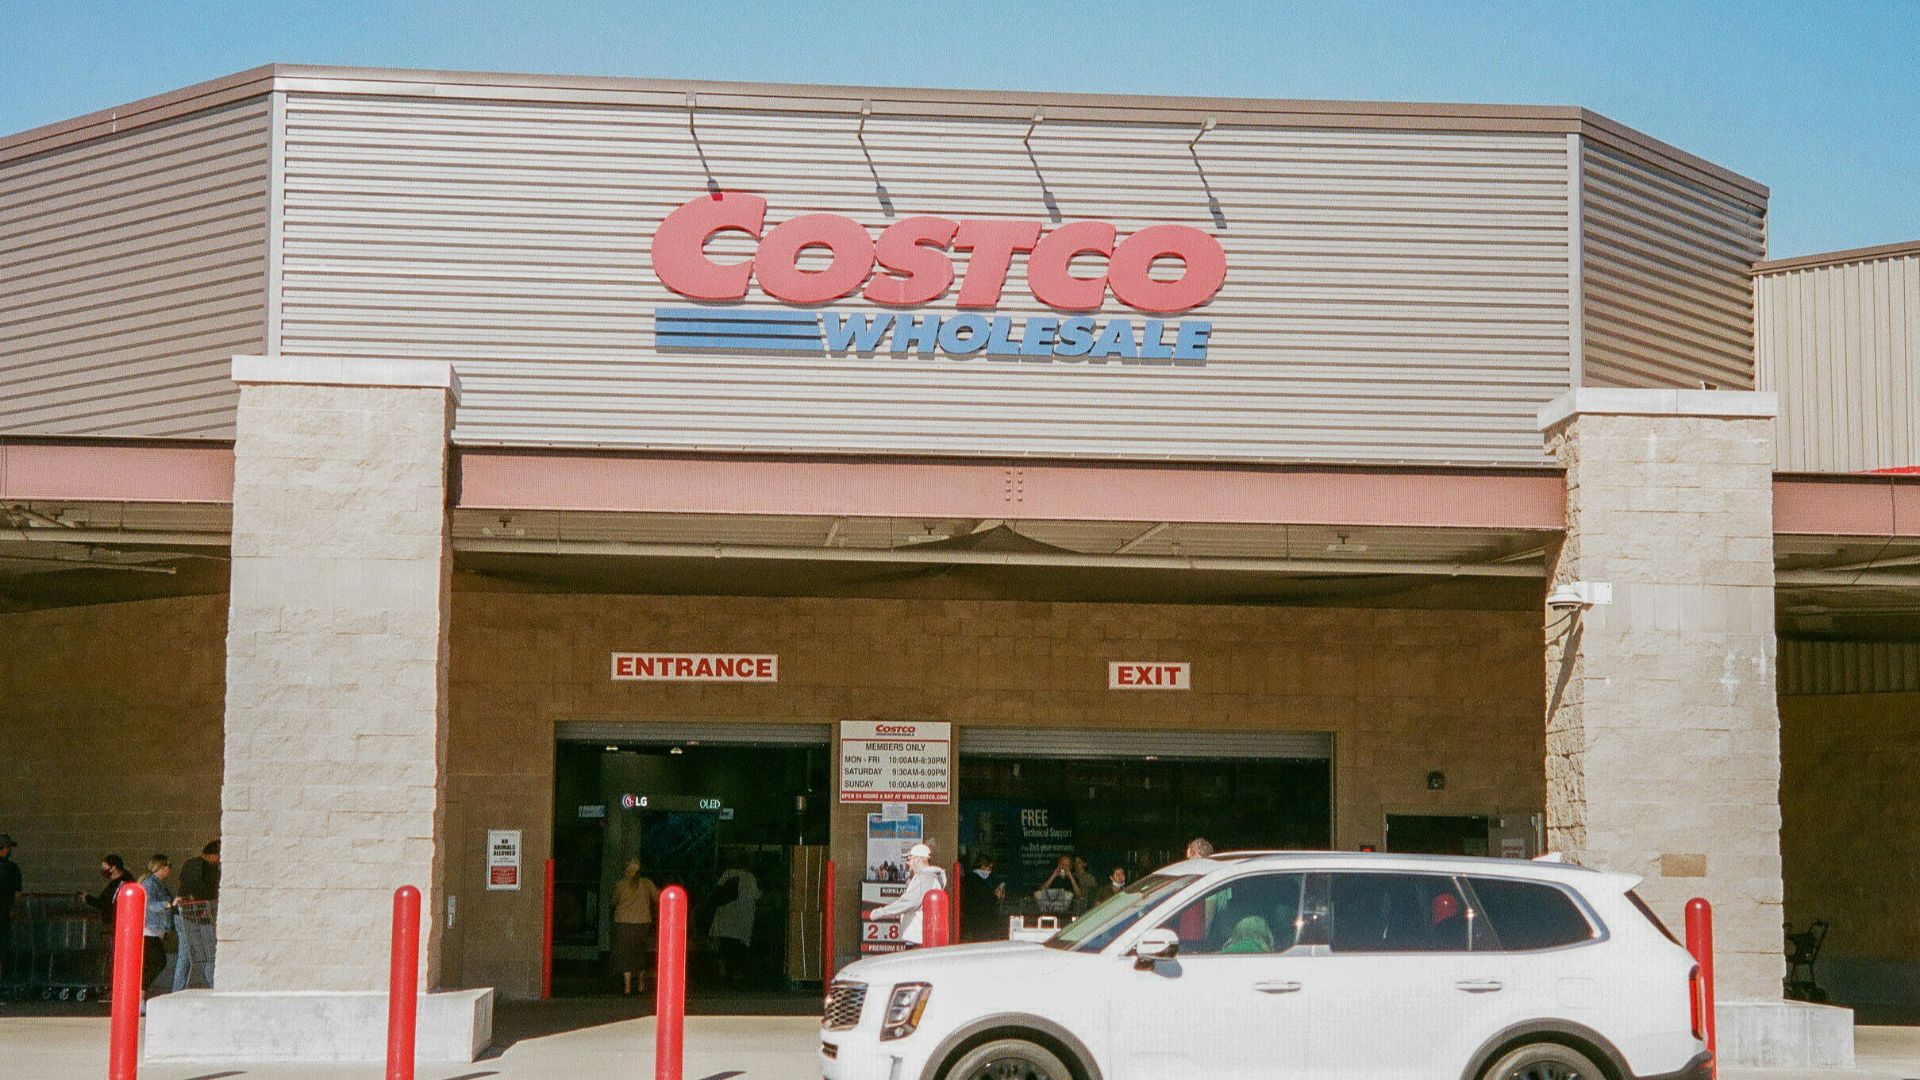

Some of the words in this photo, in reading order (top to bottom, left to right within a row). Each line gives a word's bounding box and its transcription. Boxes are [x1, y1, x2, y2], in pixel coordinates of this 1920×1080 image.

[650, 192, 1228, 312] COSTCO
[822, 312, 1213, 361] WHOLESALE
[616, 657, 773, 679] ENTRANCE
[1117, 666, 1182, 686] EXIT
[875, 724, 916, 733] COSTCO
[865, 743, 904, 751] MEMBERS
[905, 743, 926, 751] ONLY
[844, 768, 883, 776] SATURDAY
[635, 796, 648, 807] LG
[699, 799, 721, 809] OLED
[1021, 808, 1048, 827] FREE
[1022, 827, 1049, 837] Technical
[1049, 827, 1072, 840] Support
